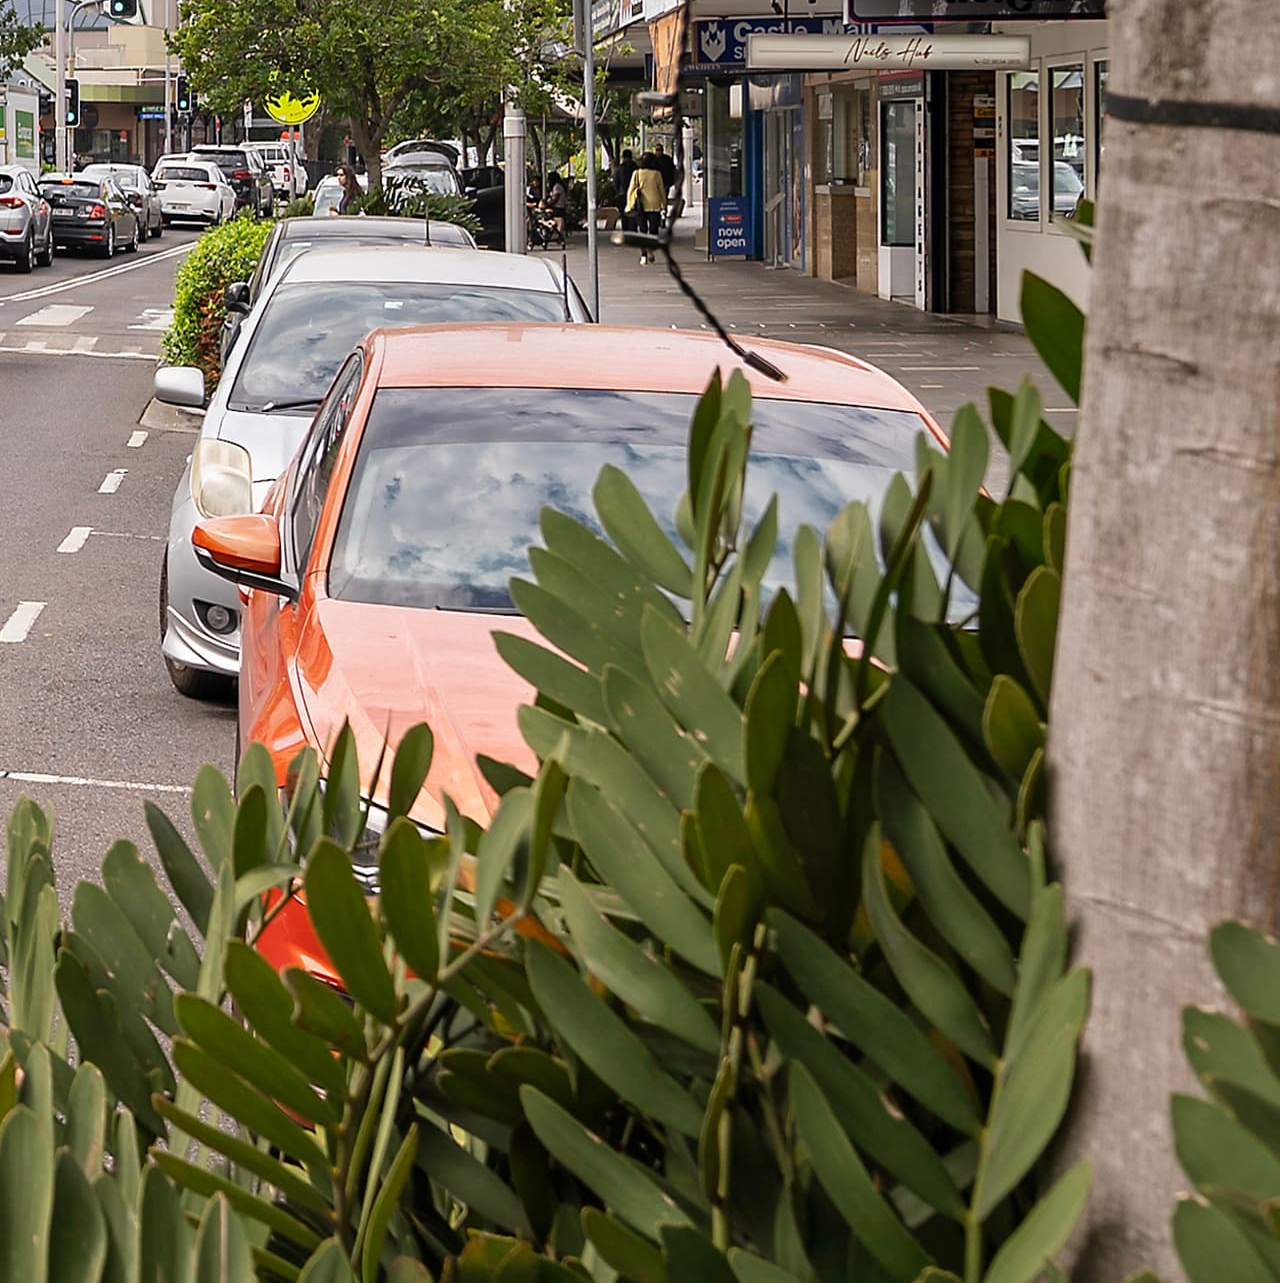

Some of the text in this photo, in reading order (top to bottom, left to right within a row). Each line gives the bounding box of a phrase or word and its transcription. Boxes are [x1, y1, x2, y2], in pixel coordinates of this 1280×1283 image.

[843, 37, 933, 67] Nails Hub
[718, 228, 743, 237] now
[716, 238, 746, 249] open
